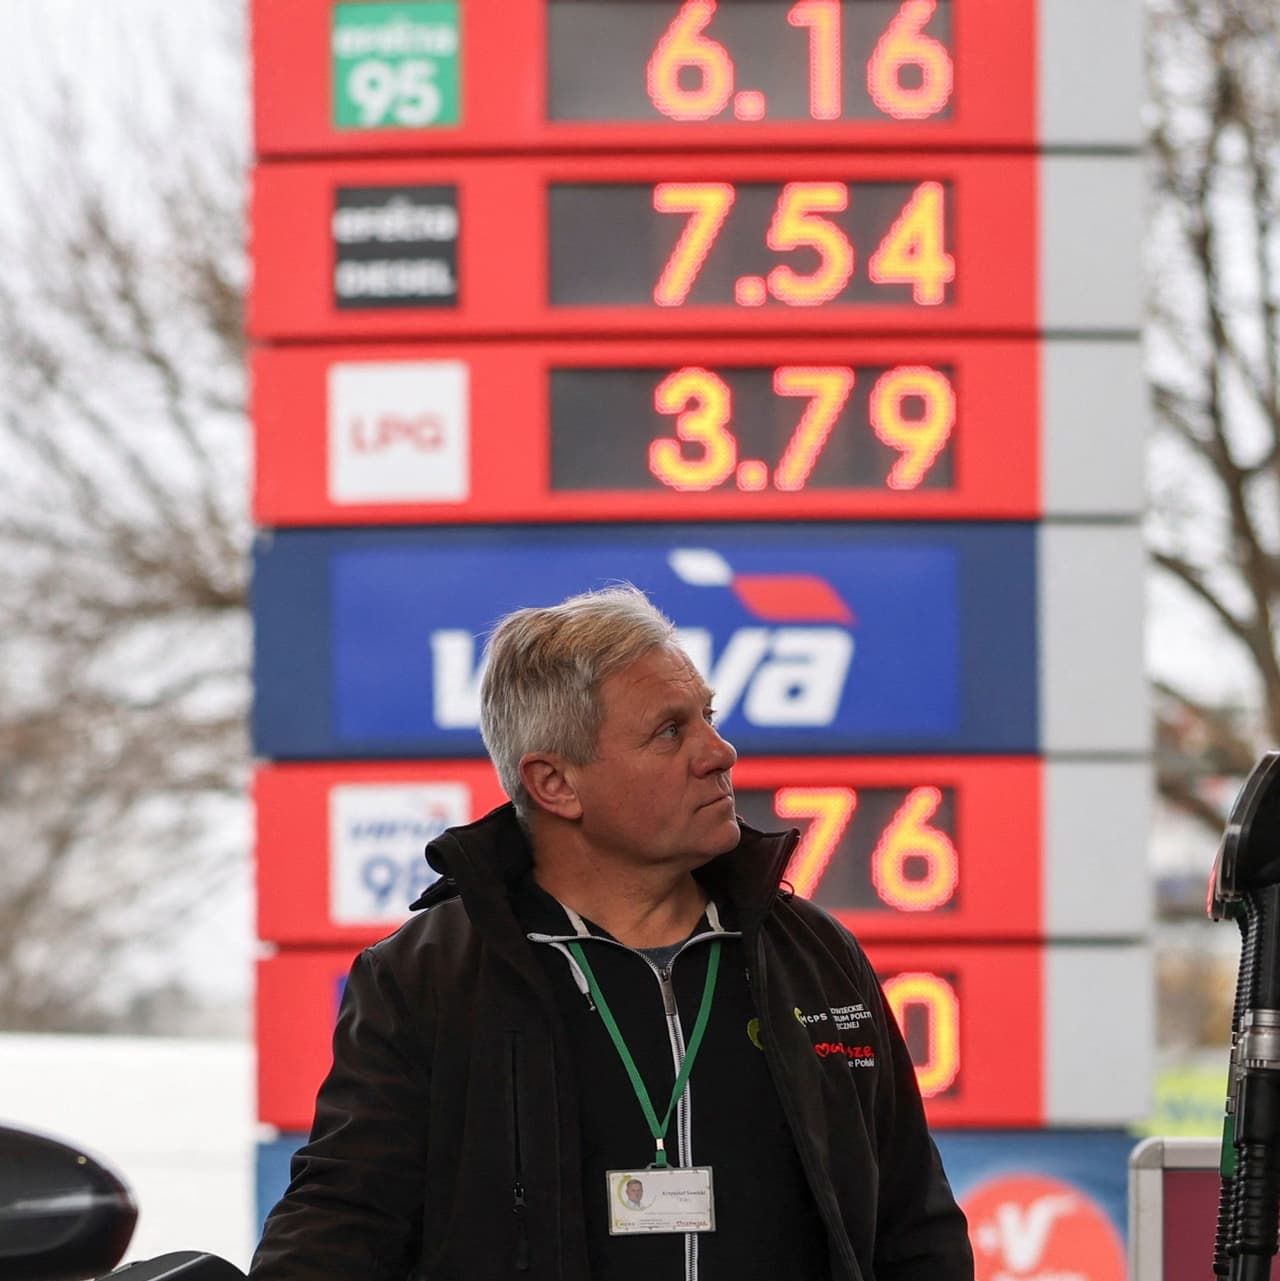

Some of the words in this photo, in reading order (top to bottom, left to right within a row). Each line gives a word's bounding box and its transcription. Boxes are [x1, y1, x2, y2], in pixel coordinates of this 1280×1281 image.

[347, 60, 442, 128] 95
[647, 0, 954, 121] 6.16
[653, 182, 955, 306] 7.54
[349, 413, 446, 456] LPG
[649, 366, 956, 492] 3.79
